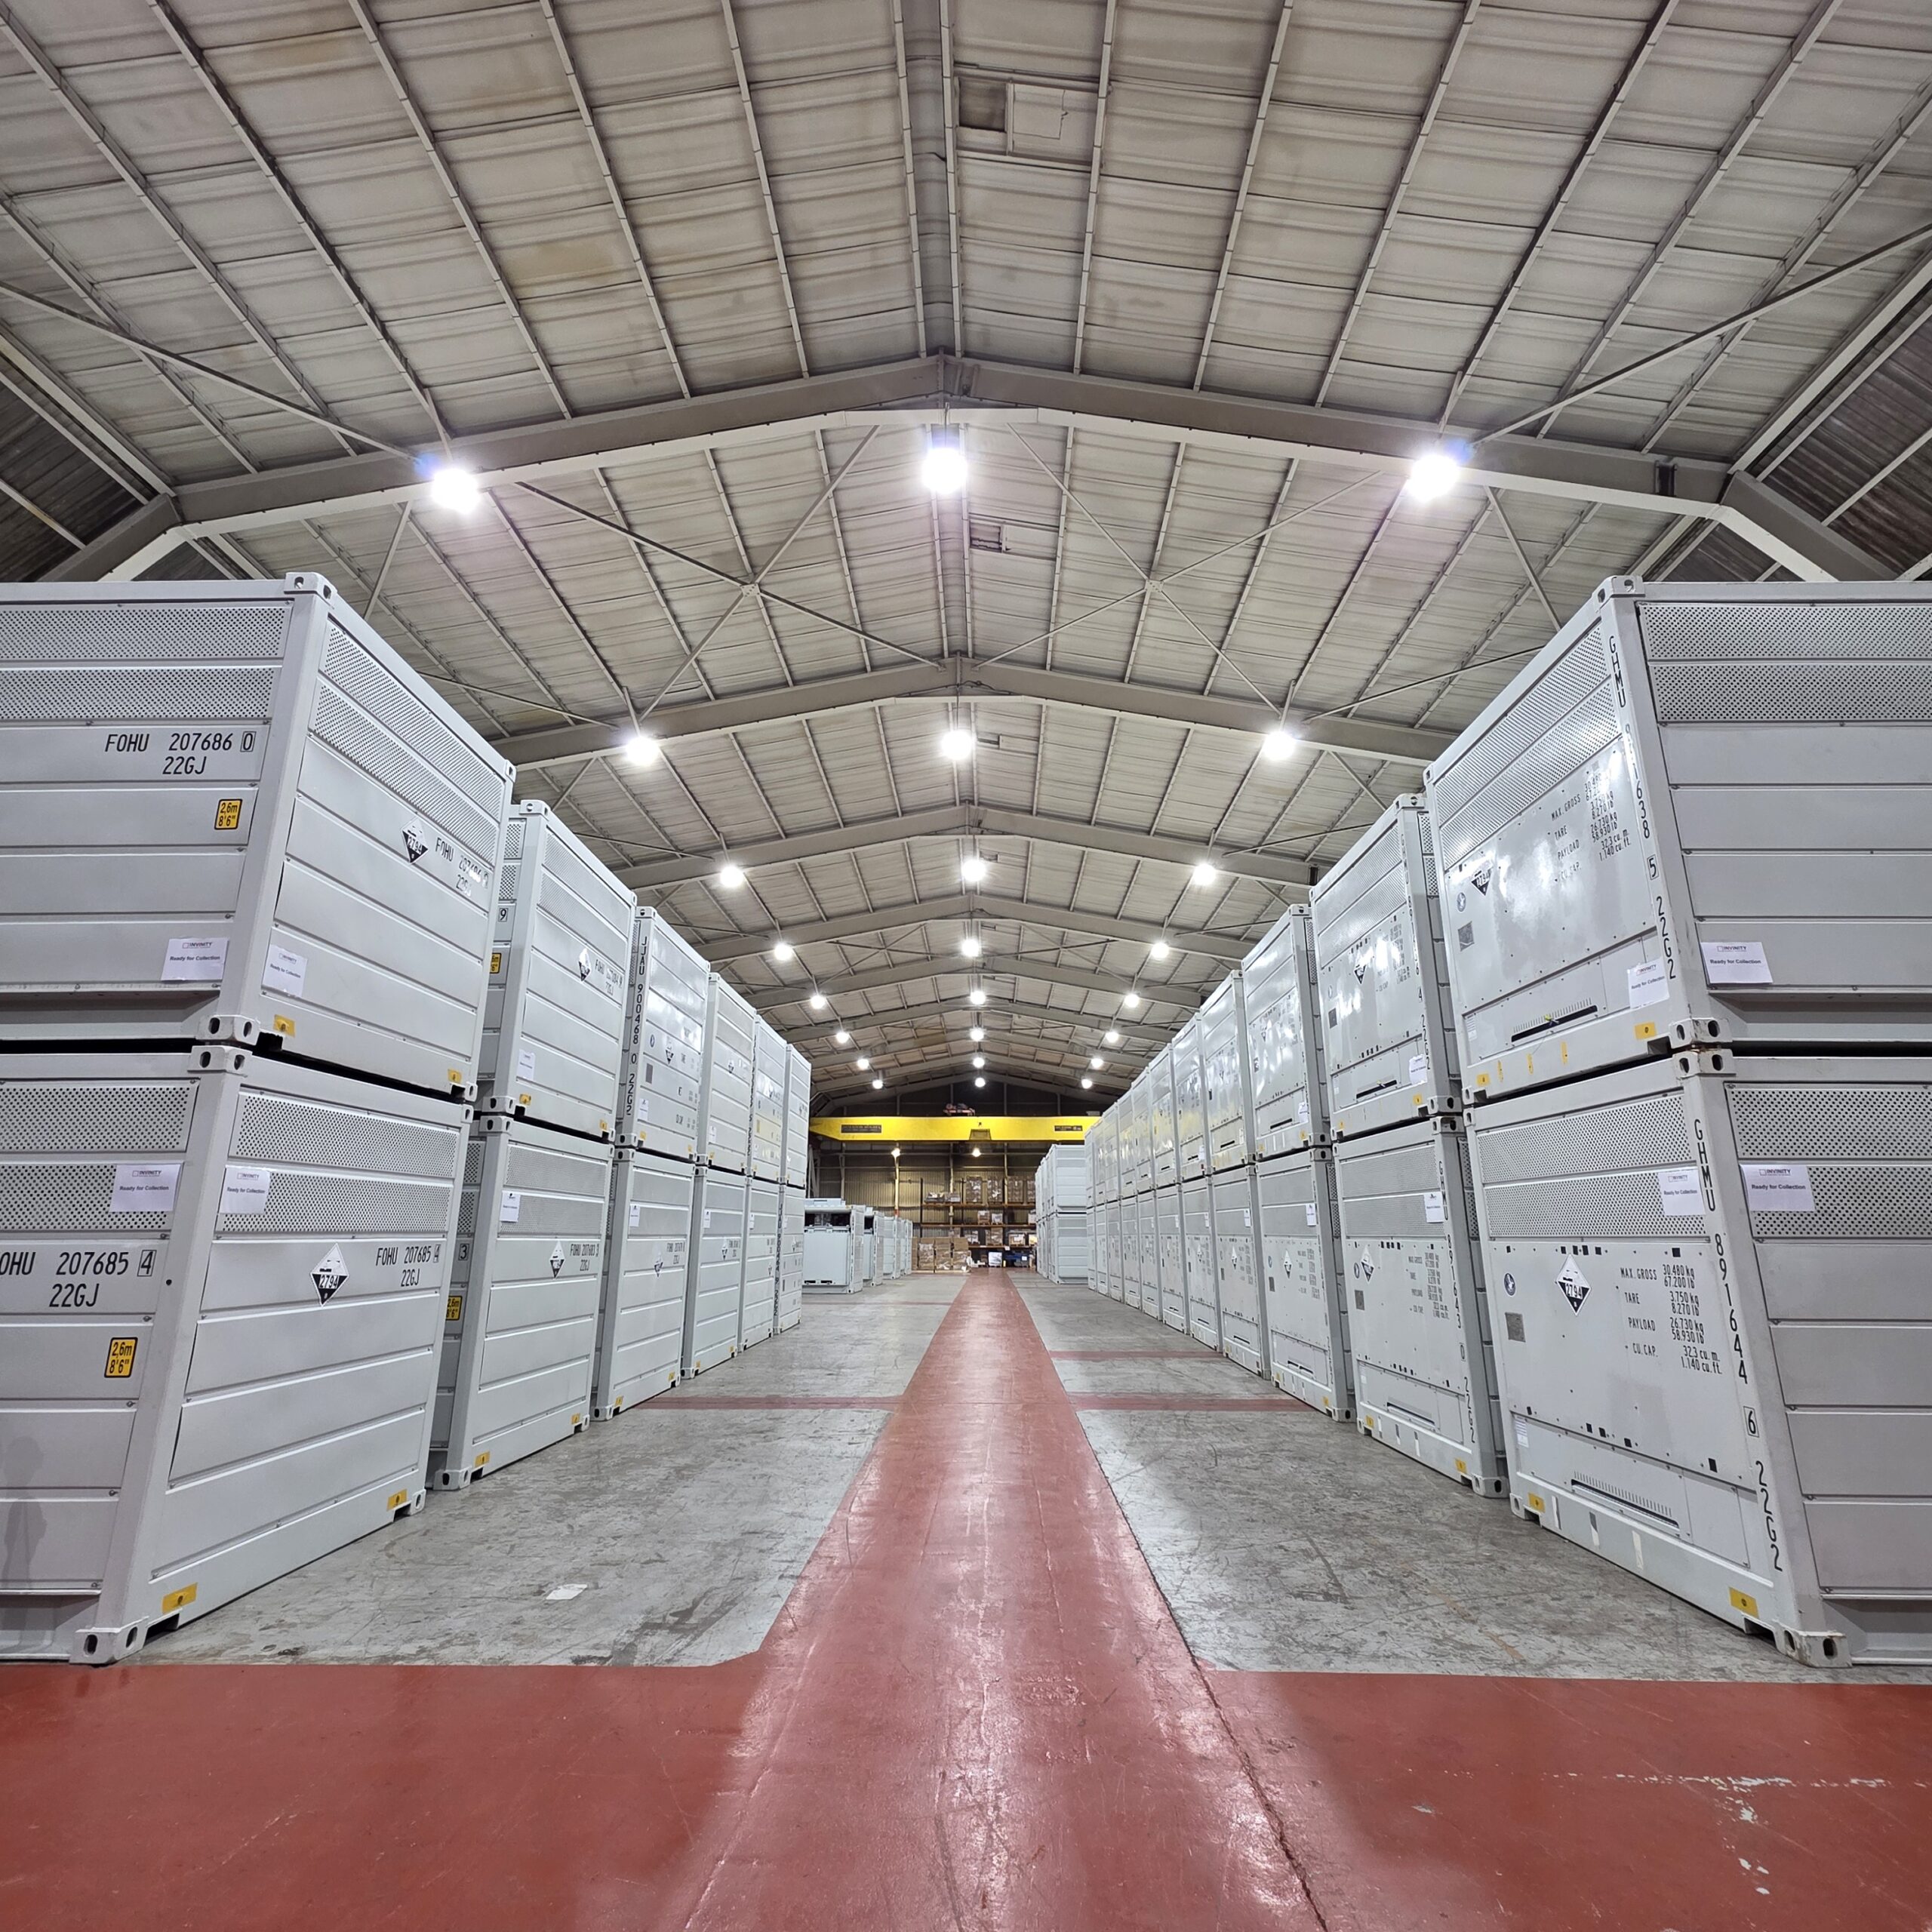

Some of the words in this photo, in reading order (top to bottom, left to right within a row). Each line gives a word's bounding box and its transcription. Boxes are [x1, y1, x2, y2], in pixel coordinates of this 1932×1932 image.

[105, 734, 149, 752] FOHU
[168, 733, 233, 752] 207686
[162, 755, 207, 775] 22GJ
[1608, 635, 1626, 708] GHMU
[1657, 896, 1676, 980] 22G2
[1555, 825, 1567, 841] TARE
[1557, 839, 1580, 861] PAYLOAD
[1590, 815, 1610, 834] 26.730
[1592, 826, 1611, 843] 58.930
[500, 909, 507, 921] 9
[639, 936, 648, 975] JJAU
[632, 984, 644, 1044] 900468
[626, 1073, 635, 1115] 22G2
[376, 1247, 398, 1266] FOHU
[404, 1245, 432, 1264] 207685
[460, 1244, 468, 1260] 3
[56, 1251, 129, 1275] 207685
[140, 1251, 153, 1275] 4
[1663, 1264, 1684, 1276] 30.480
[1685, 1265, 1695, 1280] kg
[320, 1274, 339, 1289] 2794
[401, 1268, 420, 1287] 22GJ
[1664, 1275, 1686, 1288] 67.200
[1687, 1277, 1695, 1289] lb
[49, 1283, 100, 1307] 22GJ
[1624, 1292, 1640, 1305] TARE
[1669, 1291, 1689, 1303] 3.750
[1690, 1292, 1699, 1307] kg
[1672, 1303, 1690, 1315] 8.270
[1691, 1304, 1700, 1317] lb
[1628, 1317, 1656, 1331] PAYLOAD
[1670, 1317, 1693, 1331] 26.730
[1694, 1320, 1704, 1336] kg
[1447, 1235, 1461, 1329] 891643
[1464, 1377, 1475, 1443] 22G2
[1672, 1329, 1696, 1343] 58.930
[1696, 1332, 1704, 1344] lb
[1694, 1119, 1716, 1212] GHMU
[1714, 1233, 1748, 1385] 891644
[1755, 1460, 1783, 1572] 22G2
[112, 1342, 132, 1358] 2,6m
[109, 1359, 130, 1374] 8'6"
[1681, 1356, 1700, 1371] 1.140
